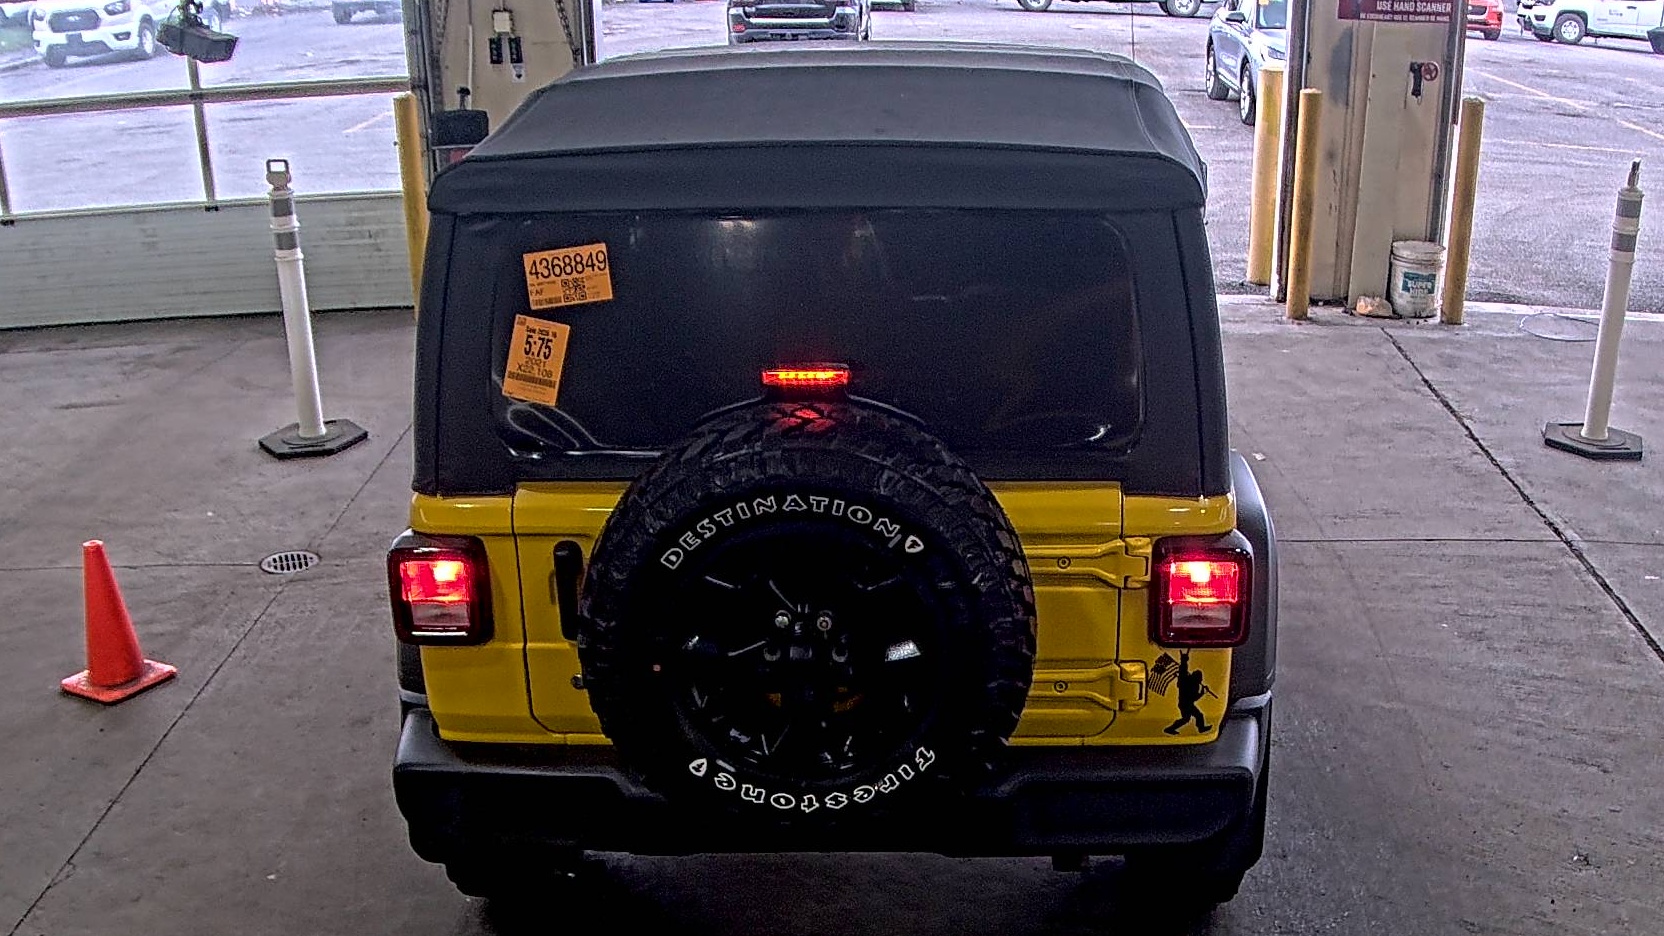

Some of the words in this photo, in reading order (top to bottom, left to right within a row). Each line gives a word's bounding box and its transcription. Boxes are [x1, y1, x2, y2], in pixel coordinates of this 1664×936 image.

[1376, 0, 1392, 11] USE
[1393, 1, 1415, 12] HAND
[1416, 2, 1452, 13] SCANNER
[528, 249, 607, 280] 4368849
[523, 334, 553, 360] 5:75
[660, 494, 901, 571] DESTINATION
